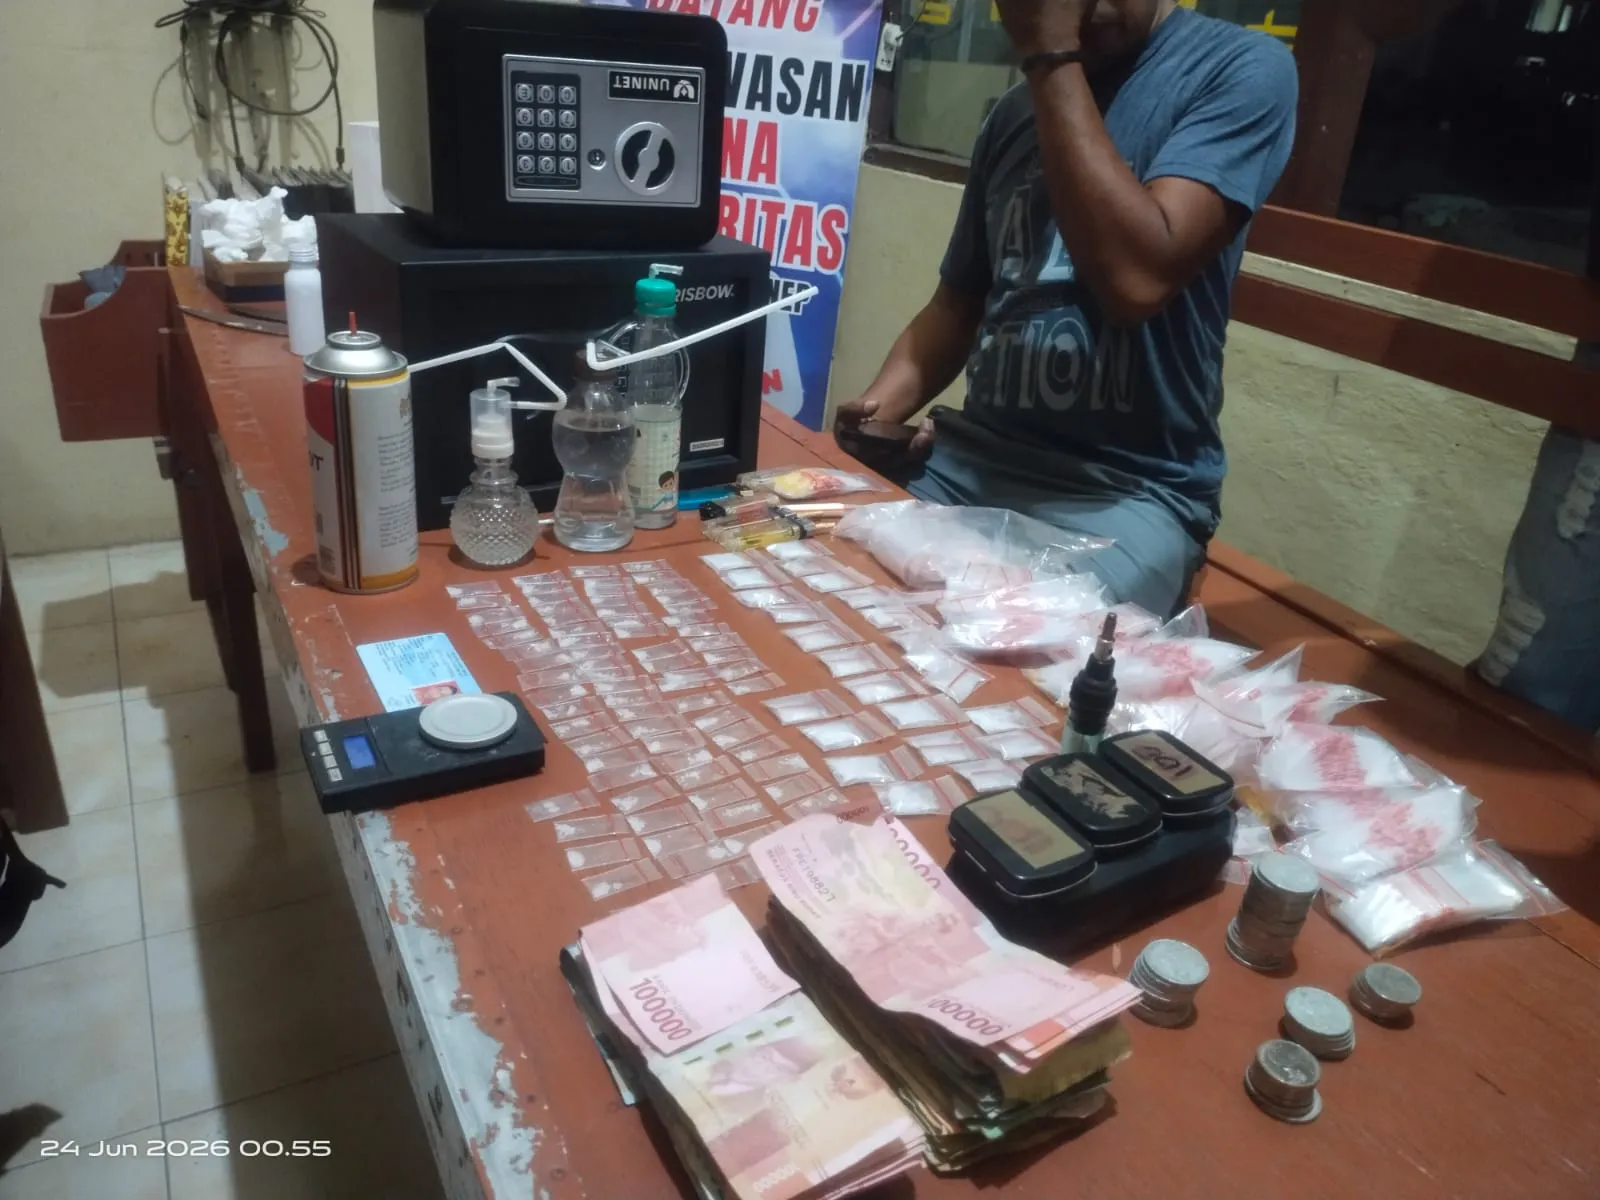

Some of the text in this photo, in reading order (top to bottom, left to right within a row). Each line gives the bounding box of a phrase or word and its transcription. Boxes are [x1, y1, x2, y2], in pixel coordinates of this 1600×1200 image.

[646, 0, 820, 32] ATANG
[613, 75, 670, 91] UNINET
[628, 977, 693, 1042] 100000
